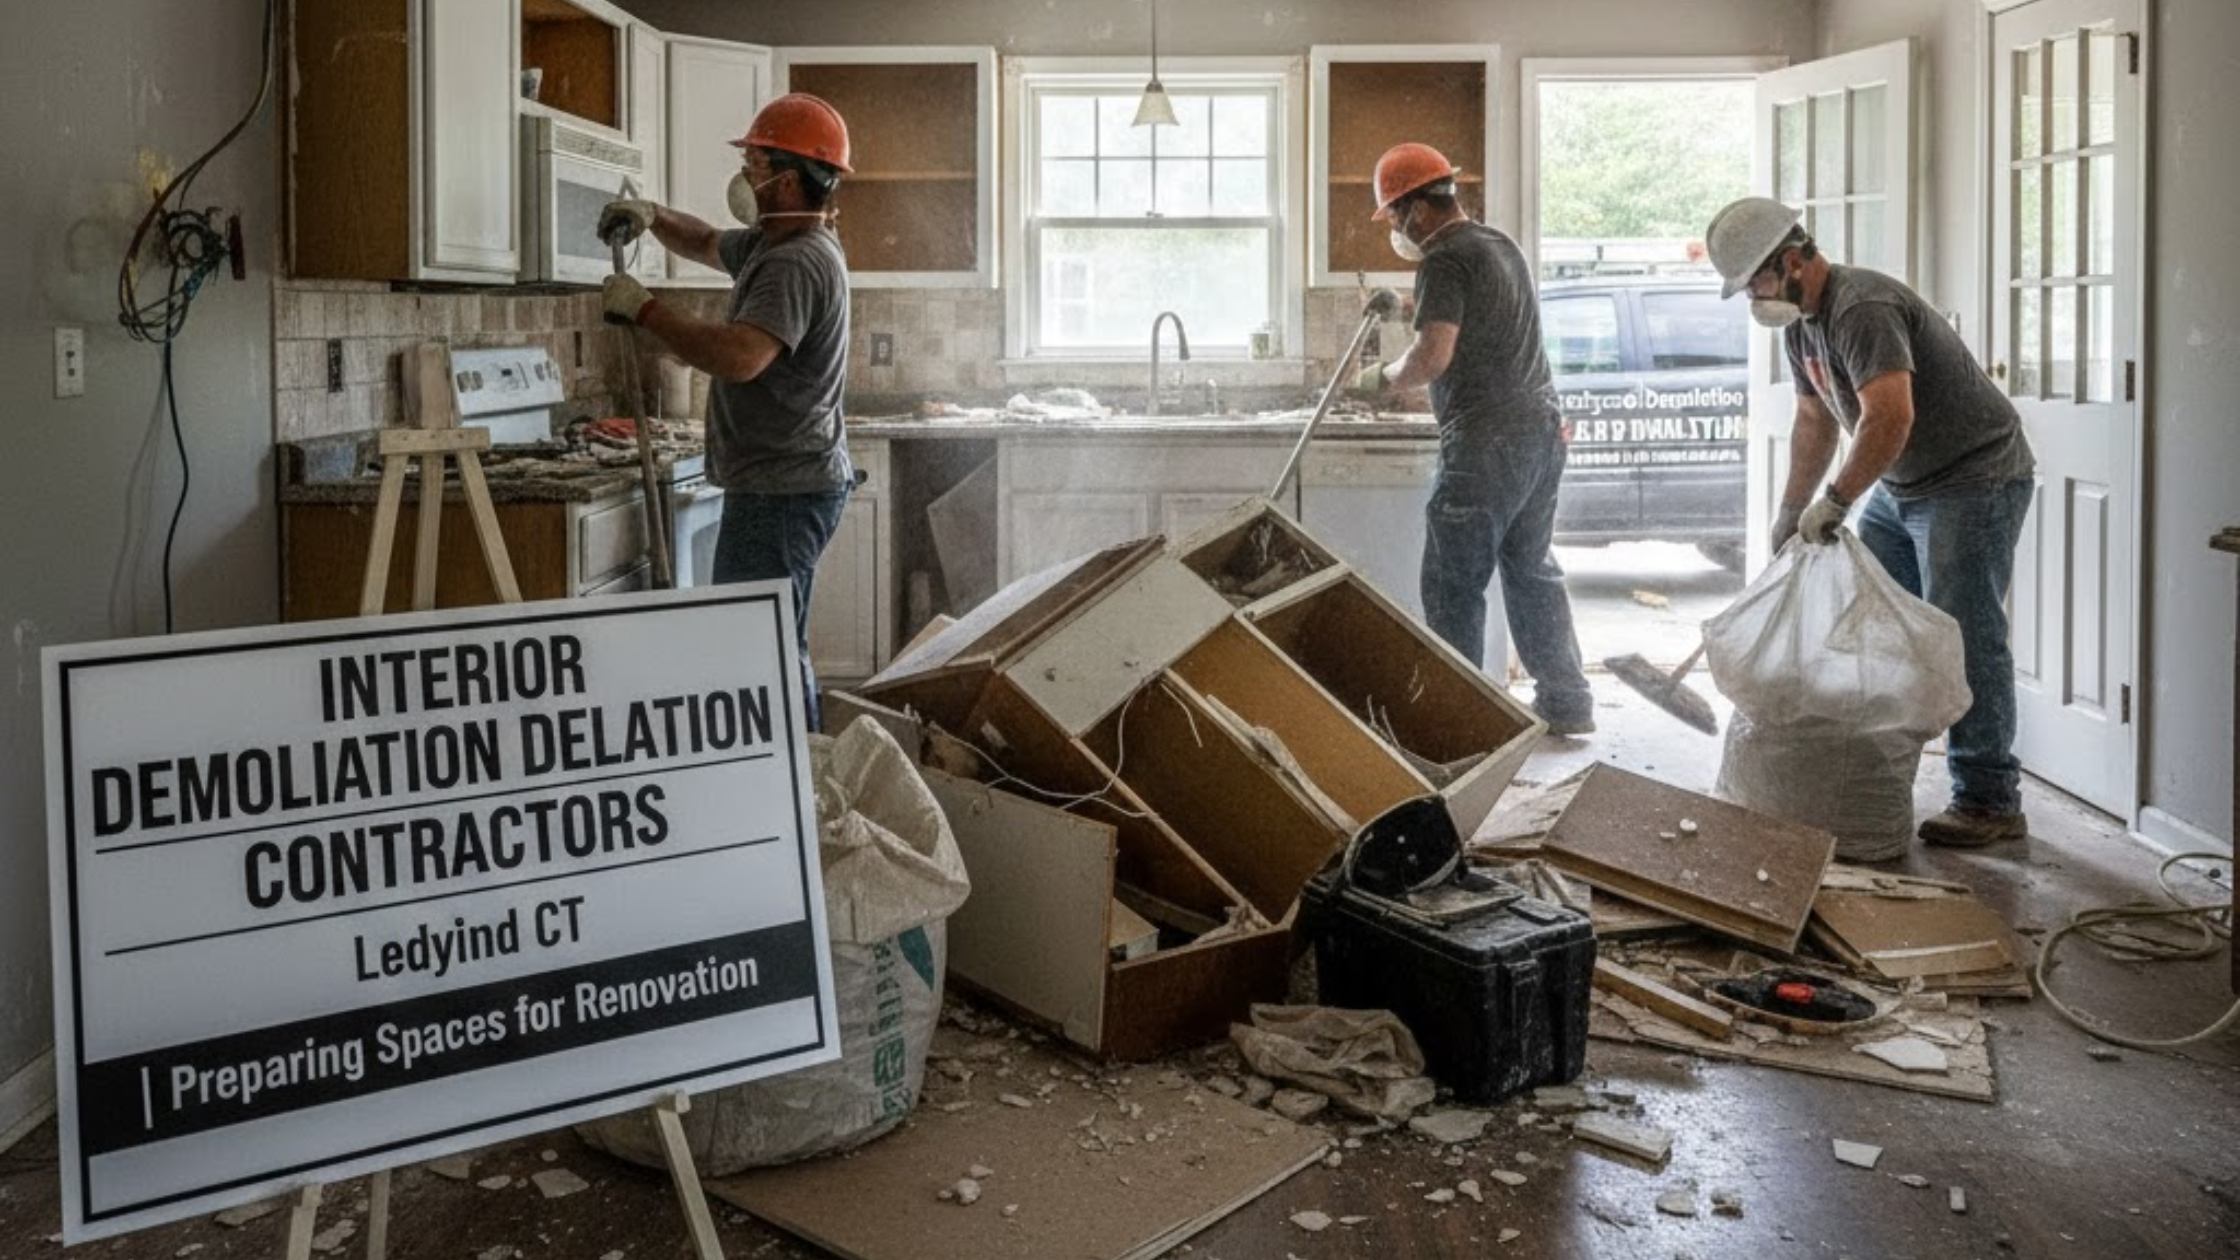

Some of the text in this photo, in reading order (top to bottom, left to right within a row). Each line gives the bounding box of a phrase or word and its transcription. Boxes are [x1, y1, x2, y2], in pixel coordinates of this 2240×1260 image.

[319, 634, 587, 723] INTERIOR
[90, 685, 773, 838] DEMOLIATION DELATION
[244, 783, 669, 910] CONTRACTORS
[353, 895, 585, 983] Ledyind CT
[172, 956, 758, 1109] Preparing Spaces for Renovation
